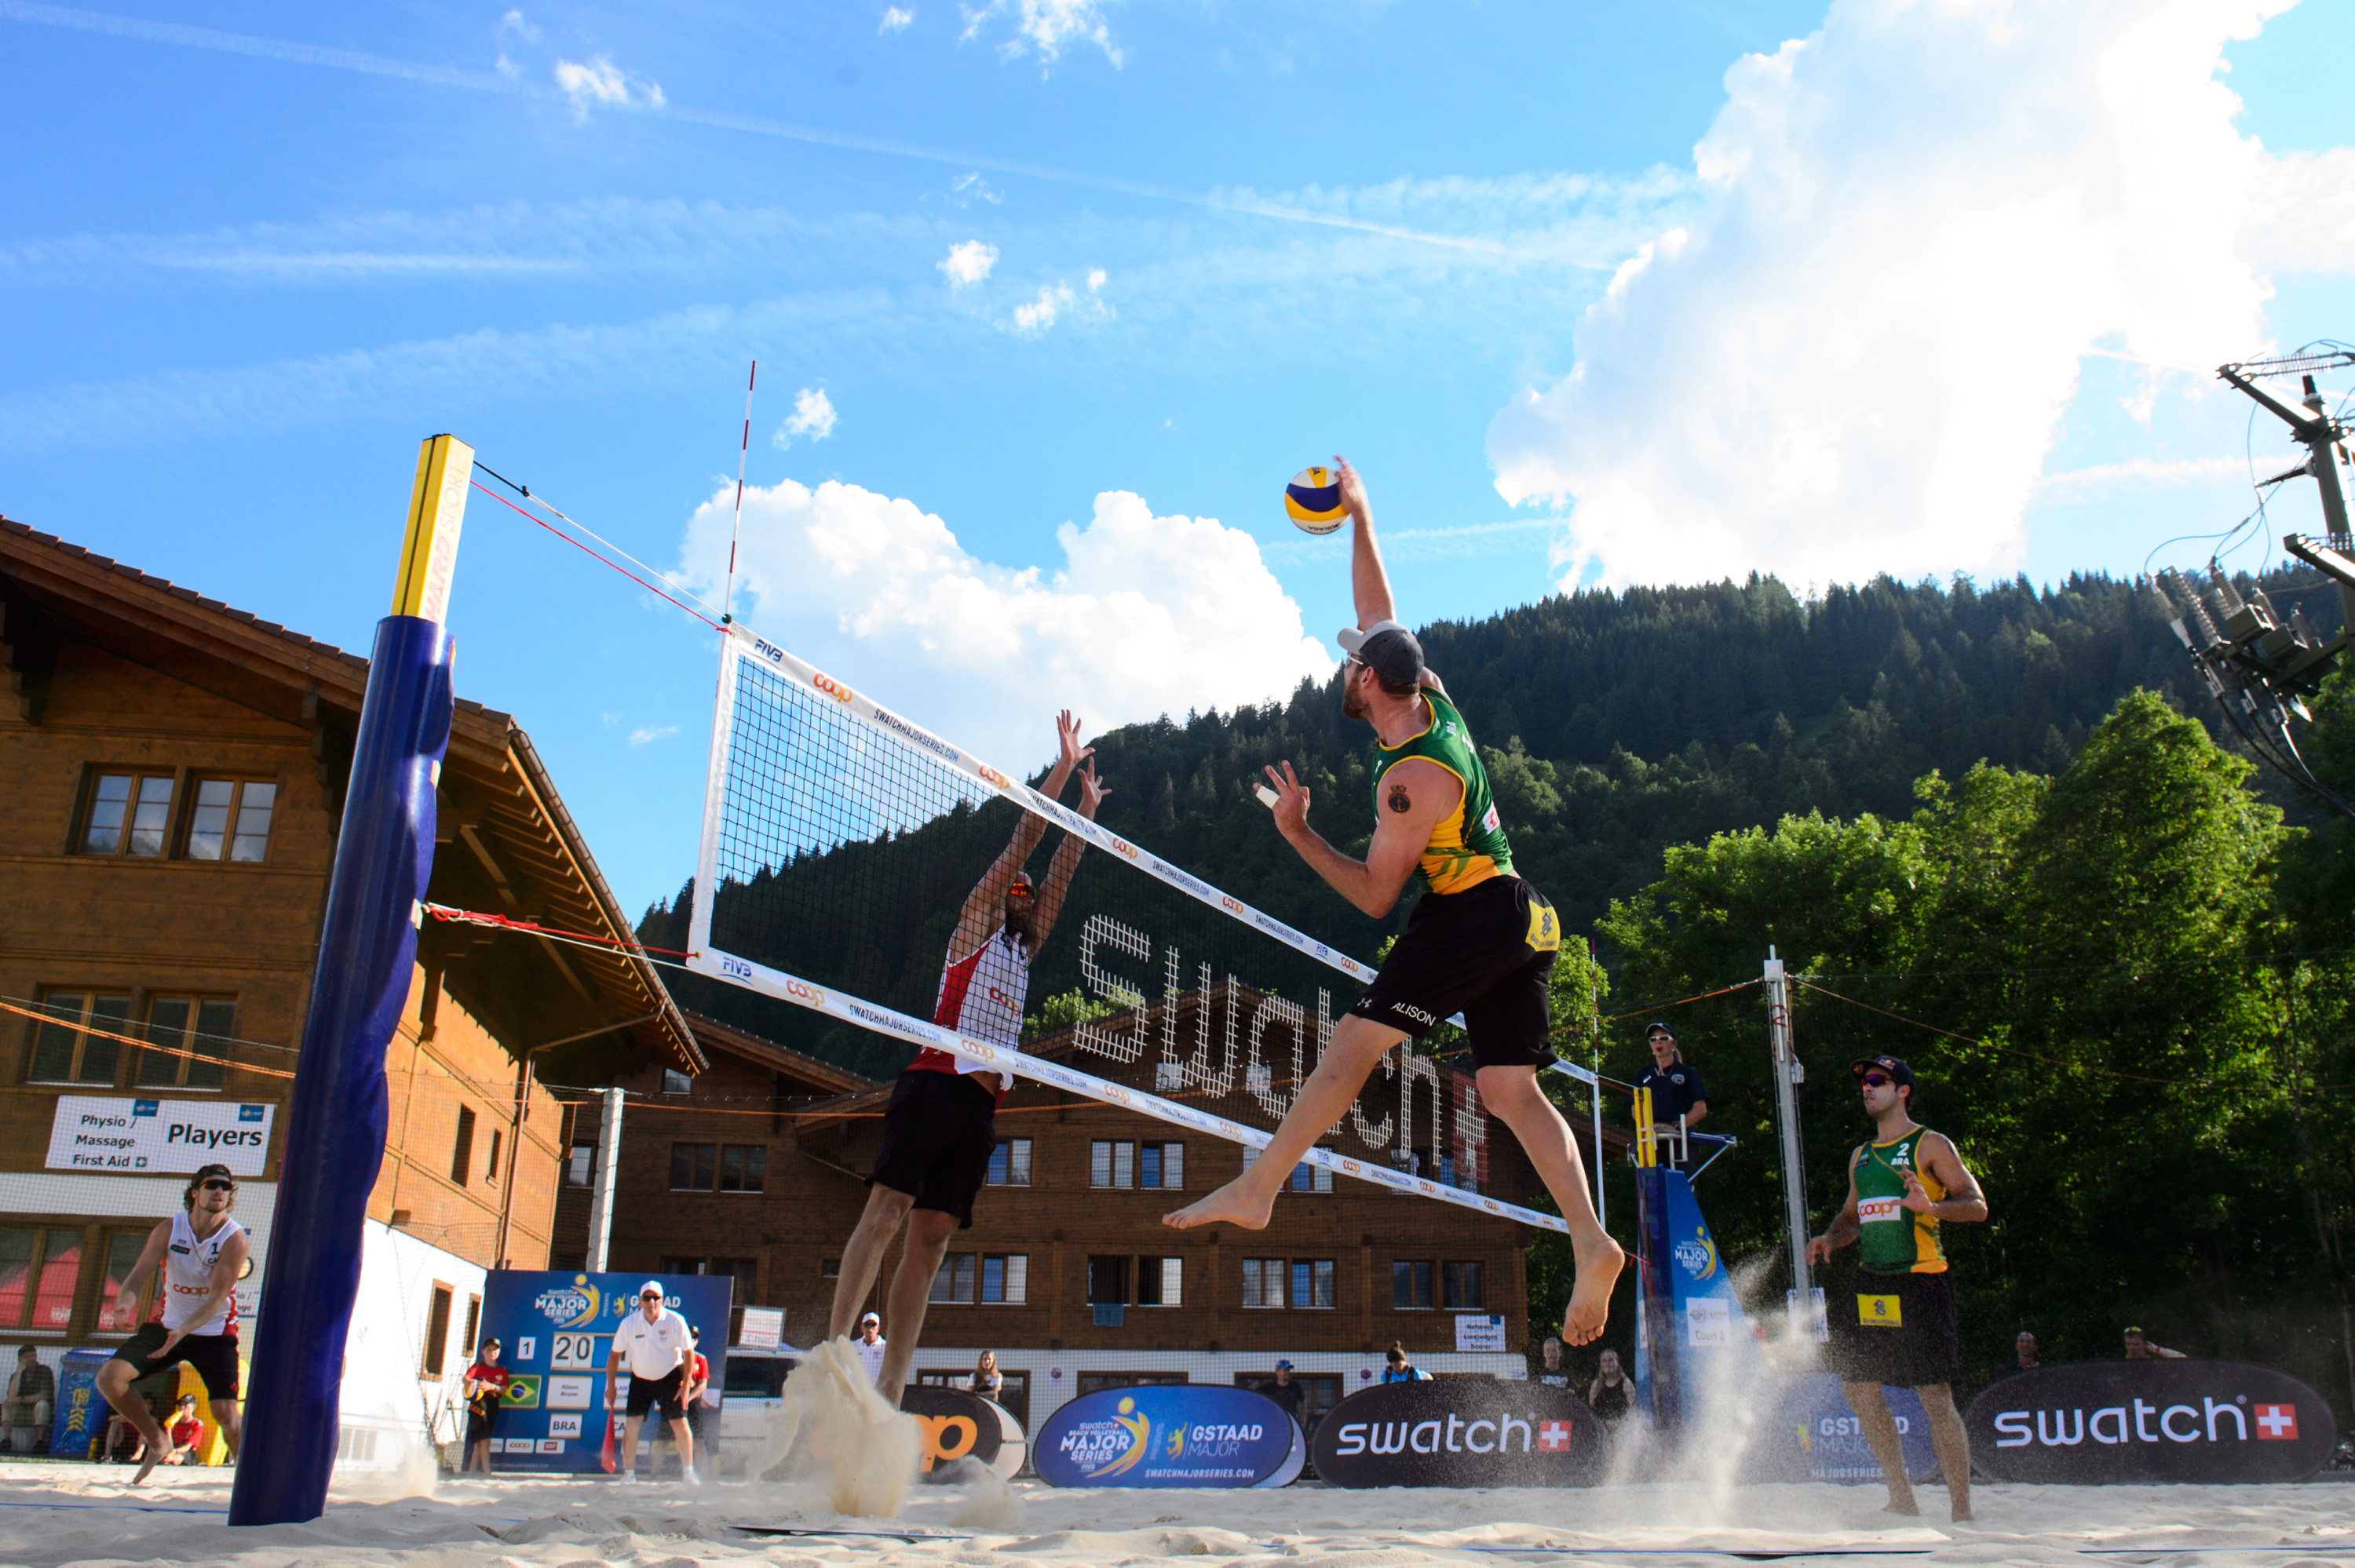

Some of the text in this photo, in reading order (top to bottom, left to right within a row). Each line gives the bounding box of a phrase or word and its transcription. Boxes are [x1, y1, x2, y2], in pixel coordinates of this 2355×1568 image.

[440, 462, 465, 532] SPORT
[754, 638, 783, 663] FIVB
[813, 673, 853, 703] coop
[874, 708, 959, 764] SWATCHMAJORSERIES.COM
[979, 764, 1011, 789] coop
[1112, 837, 1138, 860] coop
[1152, 860, 1210, 896] SWATCHMAJORSERIES.COM
[1222, 896, 1244, 915] coop
[1341, 957, 1359, 973] coop
[989, 986, 1020, 1017] coop
[1391, 1001, 1437, 1027] ALISON
[723, 956, 753, 979] FIVB
[787, 979, 825, 1006] coop
[849, 1004, 942, 1043] SWATCHMAJORSERIES.COM
[961, 1038, 995, 1062] coop
[1015, 1058, 1087, 1089] SWATCHMAJORSERIES.COM
[1104, 1084, 1130, 1104] coop
[1219, 1121, 1243, 1139] coop
[1343, 1160, 1360, 1175] coop
[1419, 1180, 1436, 1194] coop
[81, 1114, 126, 1128] Physio
[75, 1134, 136, 1148] Massage
[167, 1123, 263, 1149] Players
[1897, 1143, 1910, 1157] 2
[73, 1154, 130, 1167] First Aid
[1891, 1158, 1910, 1166] BRA
[1860, 1202, 1893, 1217] coop
[211, 1242, 219, 1255] 1
[1674, 1249, 1709, 1262] MAJOR
[173, 1283, 210, 1297] coop
[535, 1297, 587, 1310] MAJOR
[630, 1295, 681, 1308] GAD
[544, 1308, 577, 1318] SERIES
[523, 1341, 531, 1355] 1
[555, 1336, 590, 1360] 20
[553, 1420, 576, 1431] BRA
[614, 1422, 625, 1431] CA
[1079, 1420, 1113, 1429] swatch
[1820, 1416, 1909, 1436] GSTD
[1994, 1397, 2247, 1448] swatch
[1192, 1424, 1263, 1442] GSTAAD
[1336, 1413, 1531, 1456] swatch
[1060, 1435, 1130, 1452] MAJOR
[1188, 1442, 1240, 1457] MAJOR
[1819, 1436, 1871, 1453] MAJO
[1071, 1449, 1114, 1460] SERIES
[1145, 1468, 1255, 1479] SWATCHMAJORSERIES.COM
